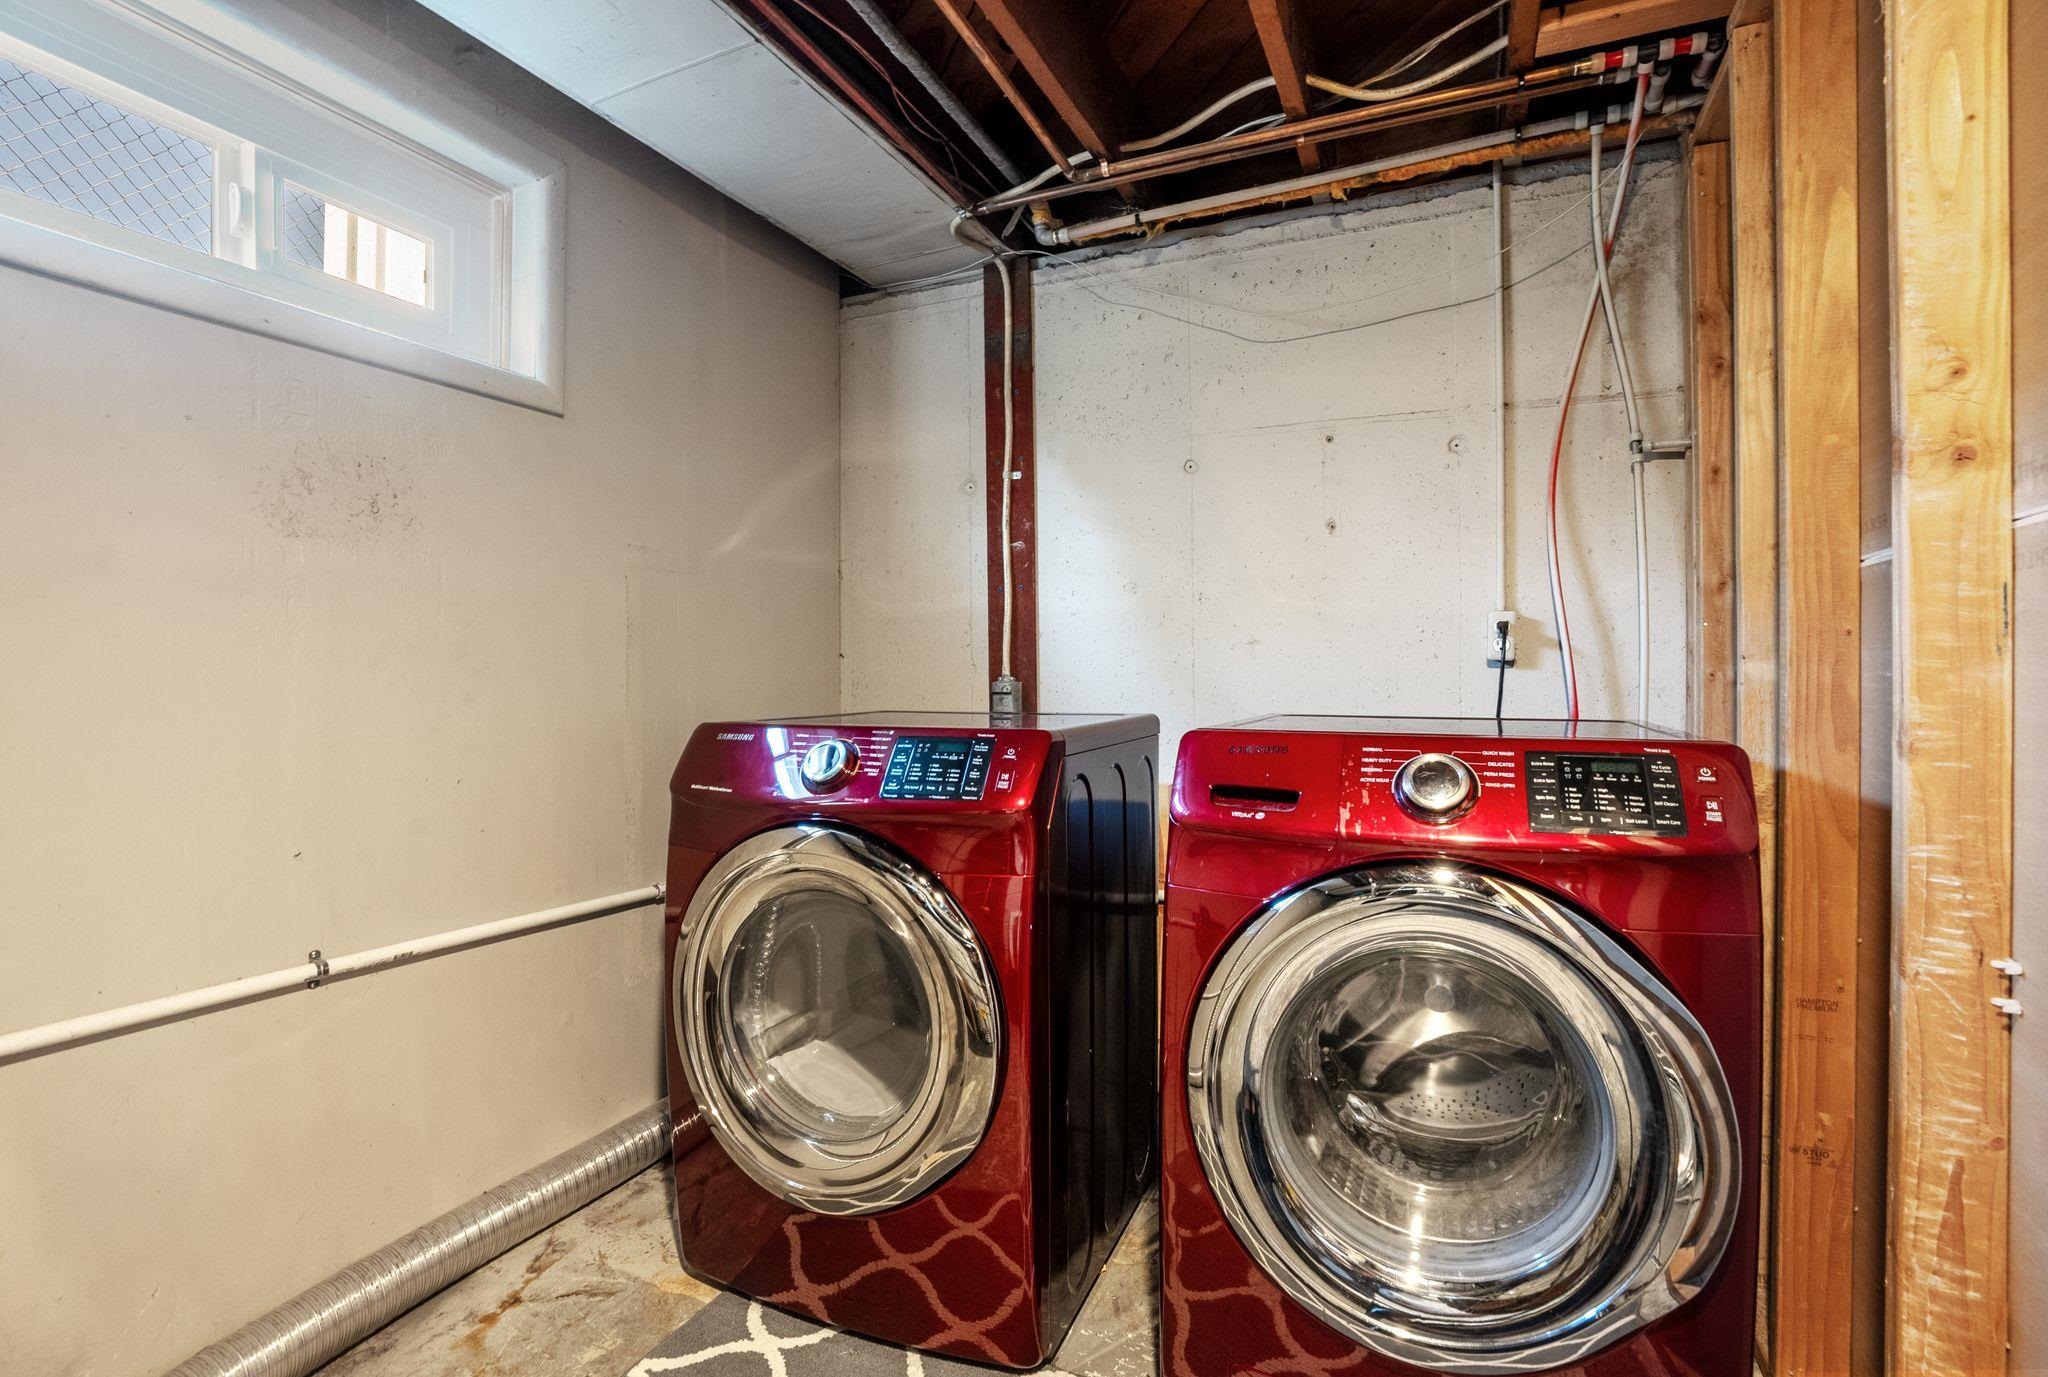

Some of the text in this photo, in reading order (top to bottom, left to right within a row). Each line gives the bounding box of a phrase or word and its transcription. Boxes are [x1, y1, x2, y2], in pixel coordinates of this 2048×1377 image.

[716, 733, 755, 741] SAMSUNG
[1795, 997, 1840, 1007] HAMPTON
[1796, 1003, 1839, 1013] PREMIUM
[1802, 1148, 1831, 1160] STUD
